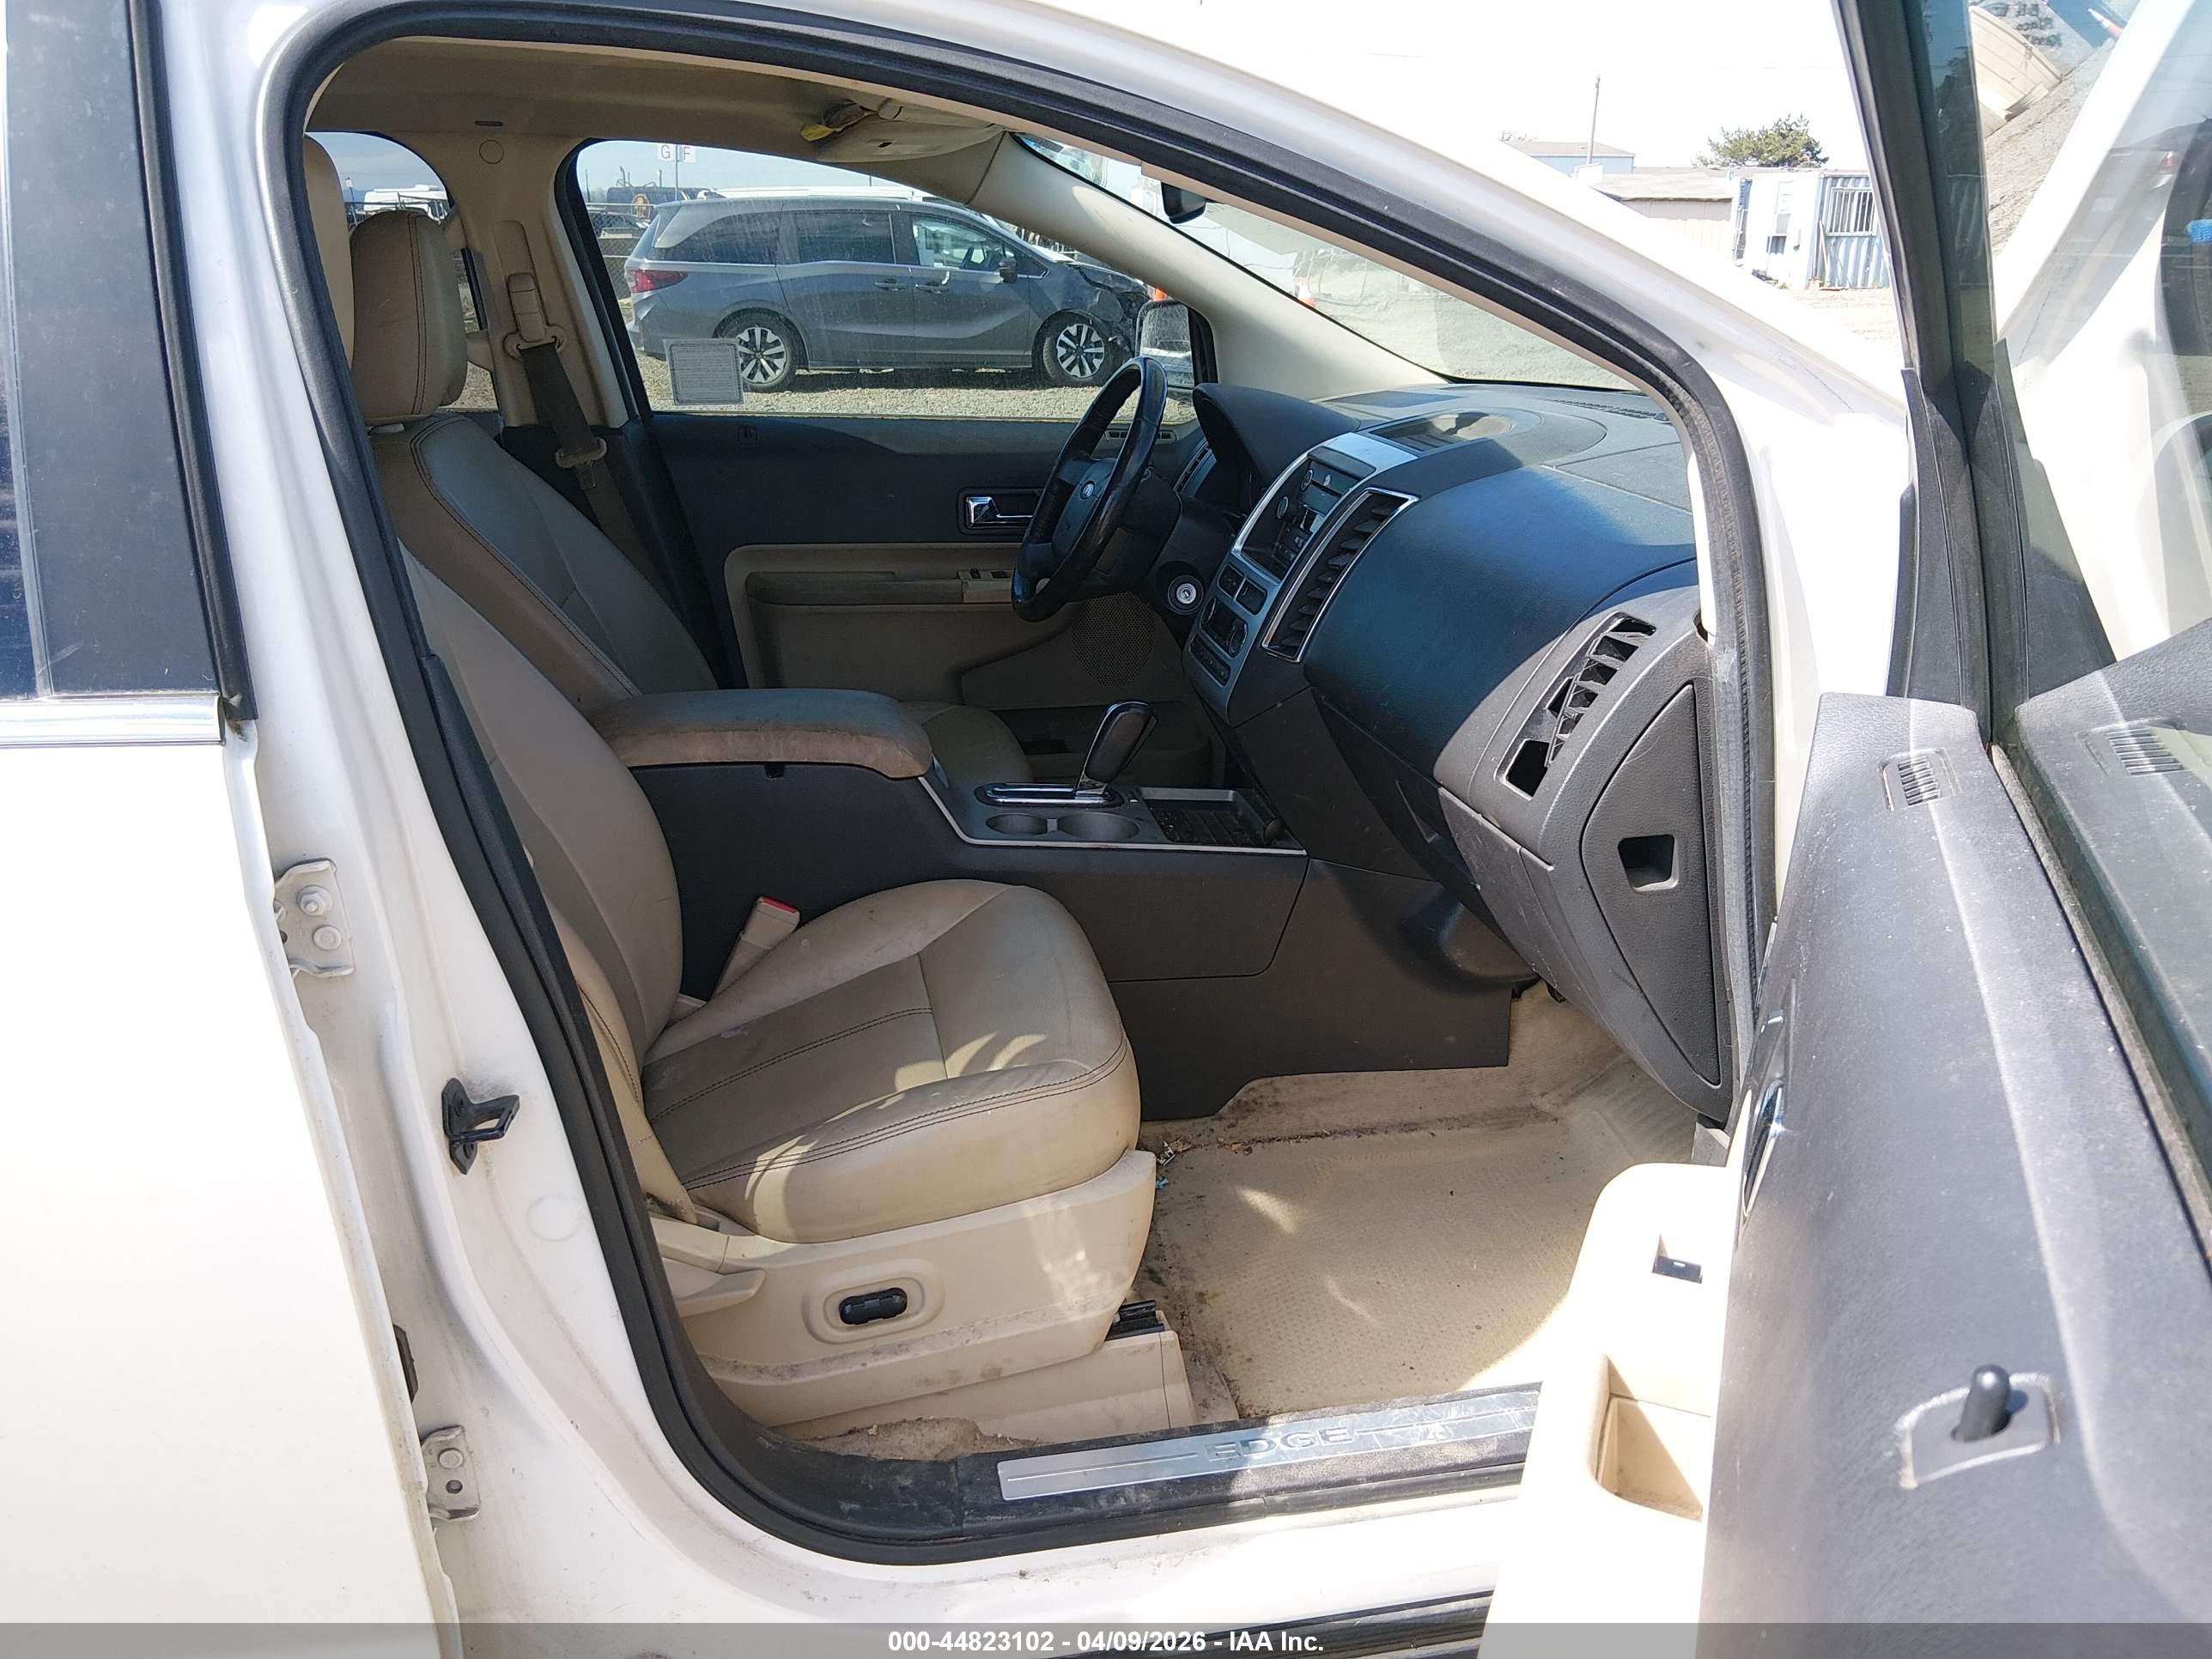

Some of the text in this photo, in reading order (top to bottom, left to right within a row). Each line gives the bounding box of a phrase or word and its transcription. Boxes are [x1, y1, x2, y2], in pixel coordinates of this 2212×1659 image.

[660, 144, 671, 159] G
[683, 146, 691, 161] F
[1206, 1425, 1354, 1462] EDGE
